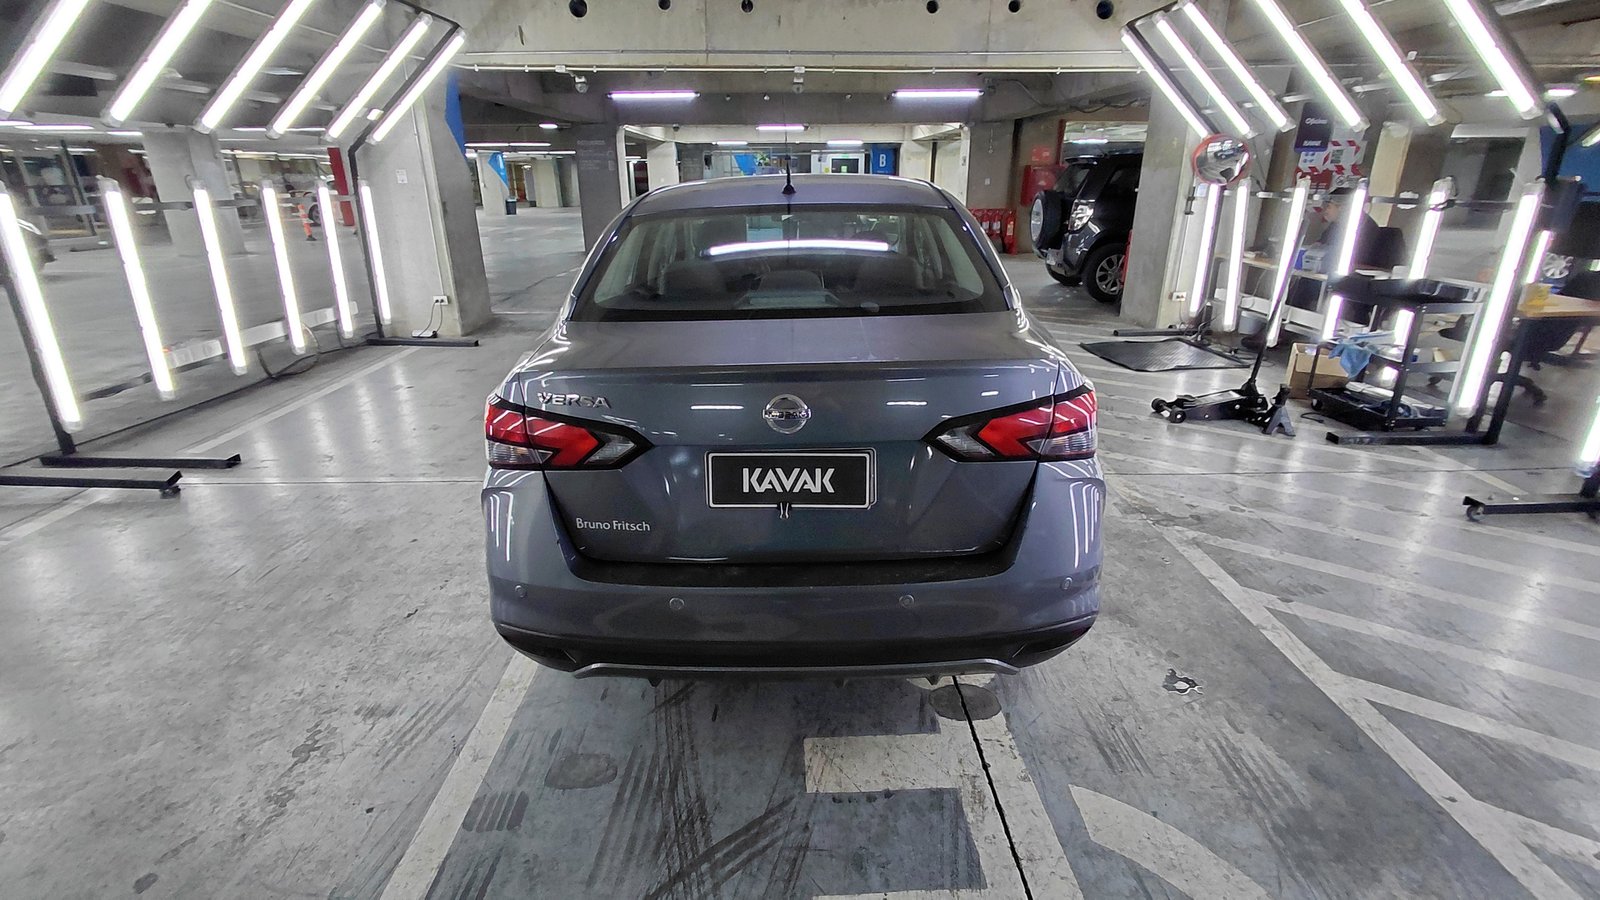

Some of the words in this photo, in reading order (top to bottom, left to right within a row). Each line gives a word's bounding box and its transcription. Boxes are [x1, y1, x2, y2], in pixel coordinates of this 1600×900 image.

[879, 154, 887, 167] B
[537, 392, 611, 409] VERSA
[742, 467, 835, 493] KAVAK
[576, 518, 611, 530] Bruno
[613, 520, 651, 531] Fritsch
